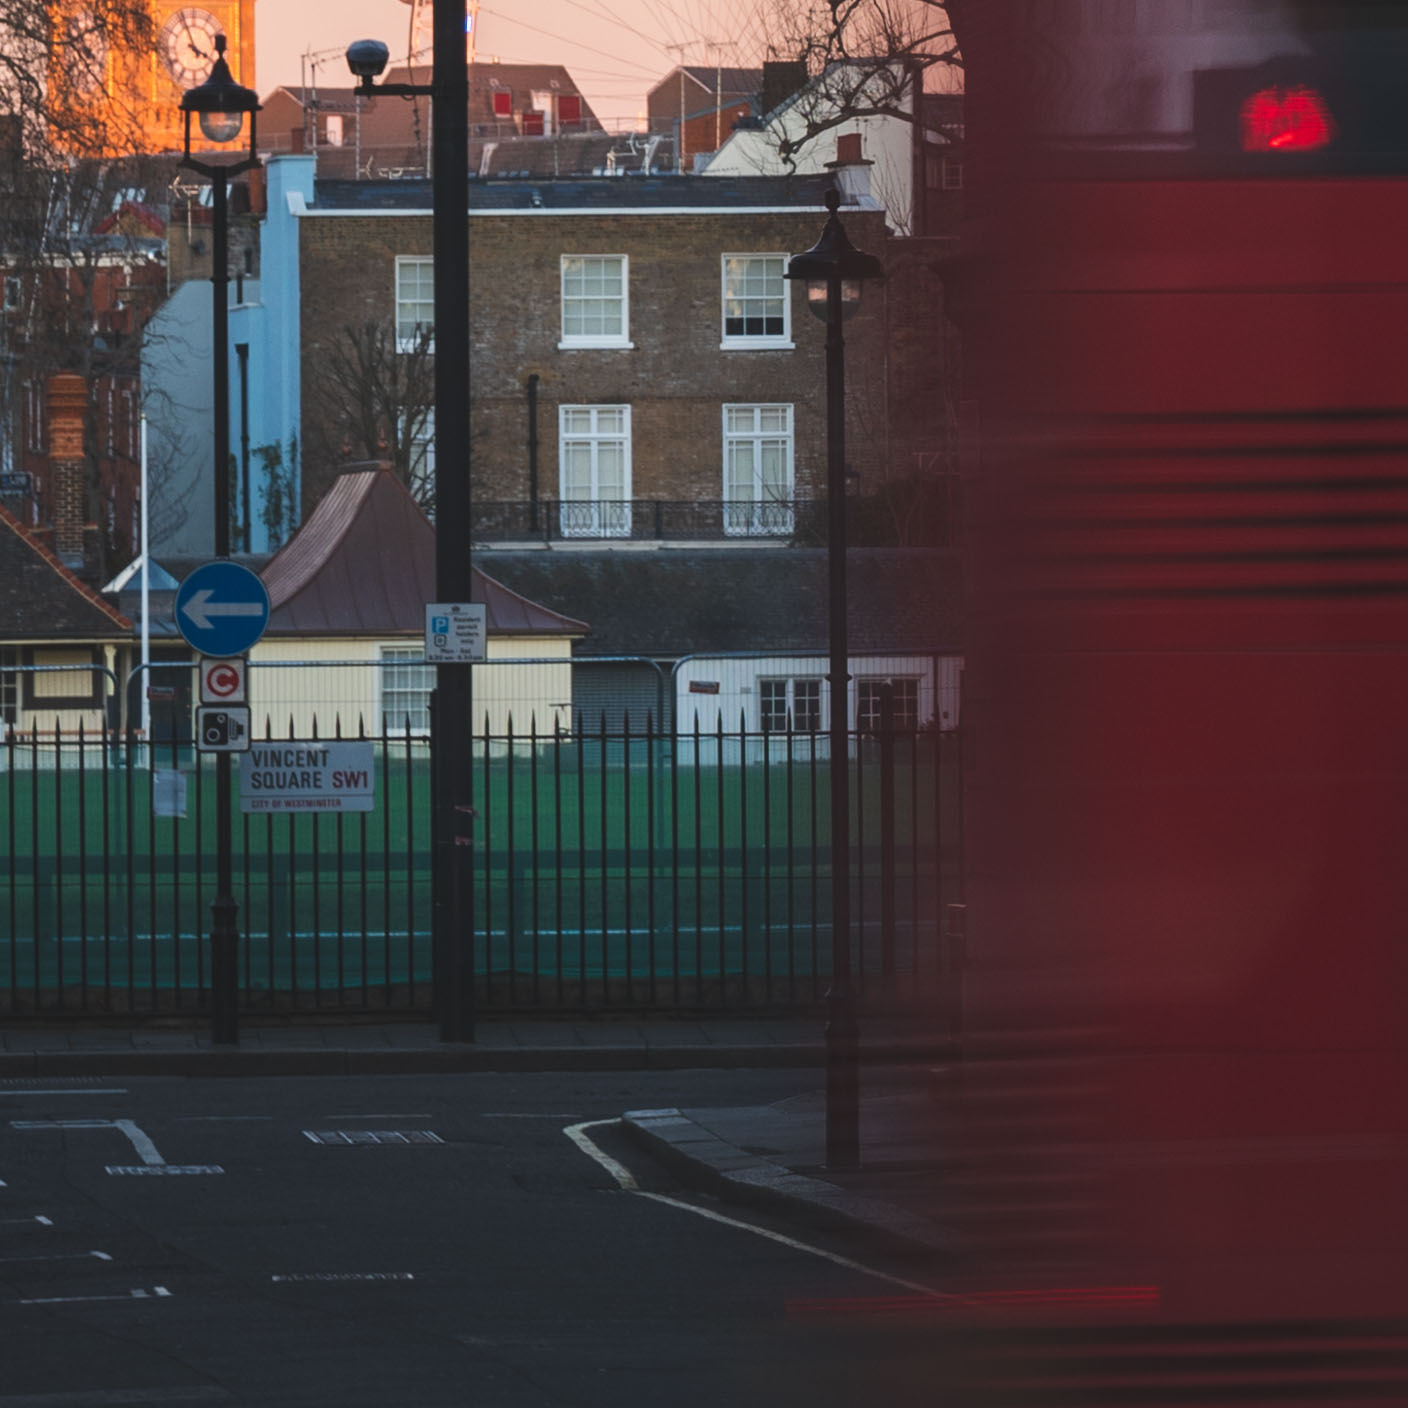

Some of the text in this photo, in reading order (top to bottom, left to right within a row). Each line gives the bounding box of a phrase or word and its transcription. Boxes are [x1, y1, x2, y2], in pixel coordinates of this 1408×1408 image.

[251, 750, 329, 768] VINCENT
[251, 770, 368, 789] SQUARE SW1
[251, 798, 342, 809] CITY OF WESTMINSTER
